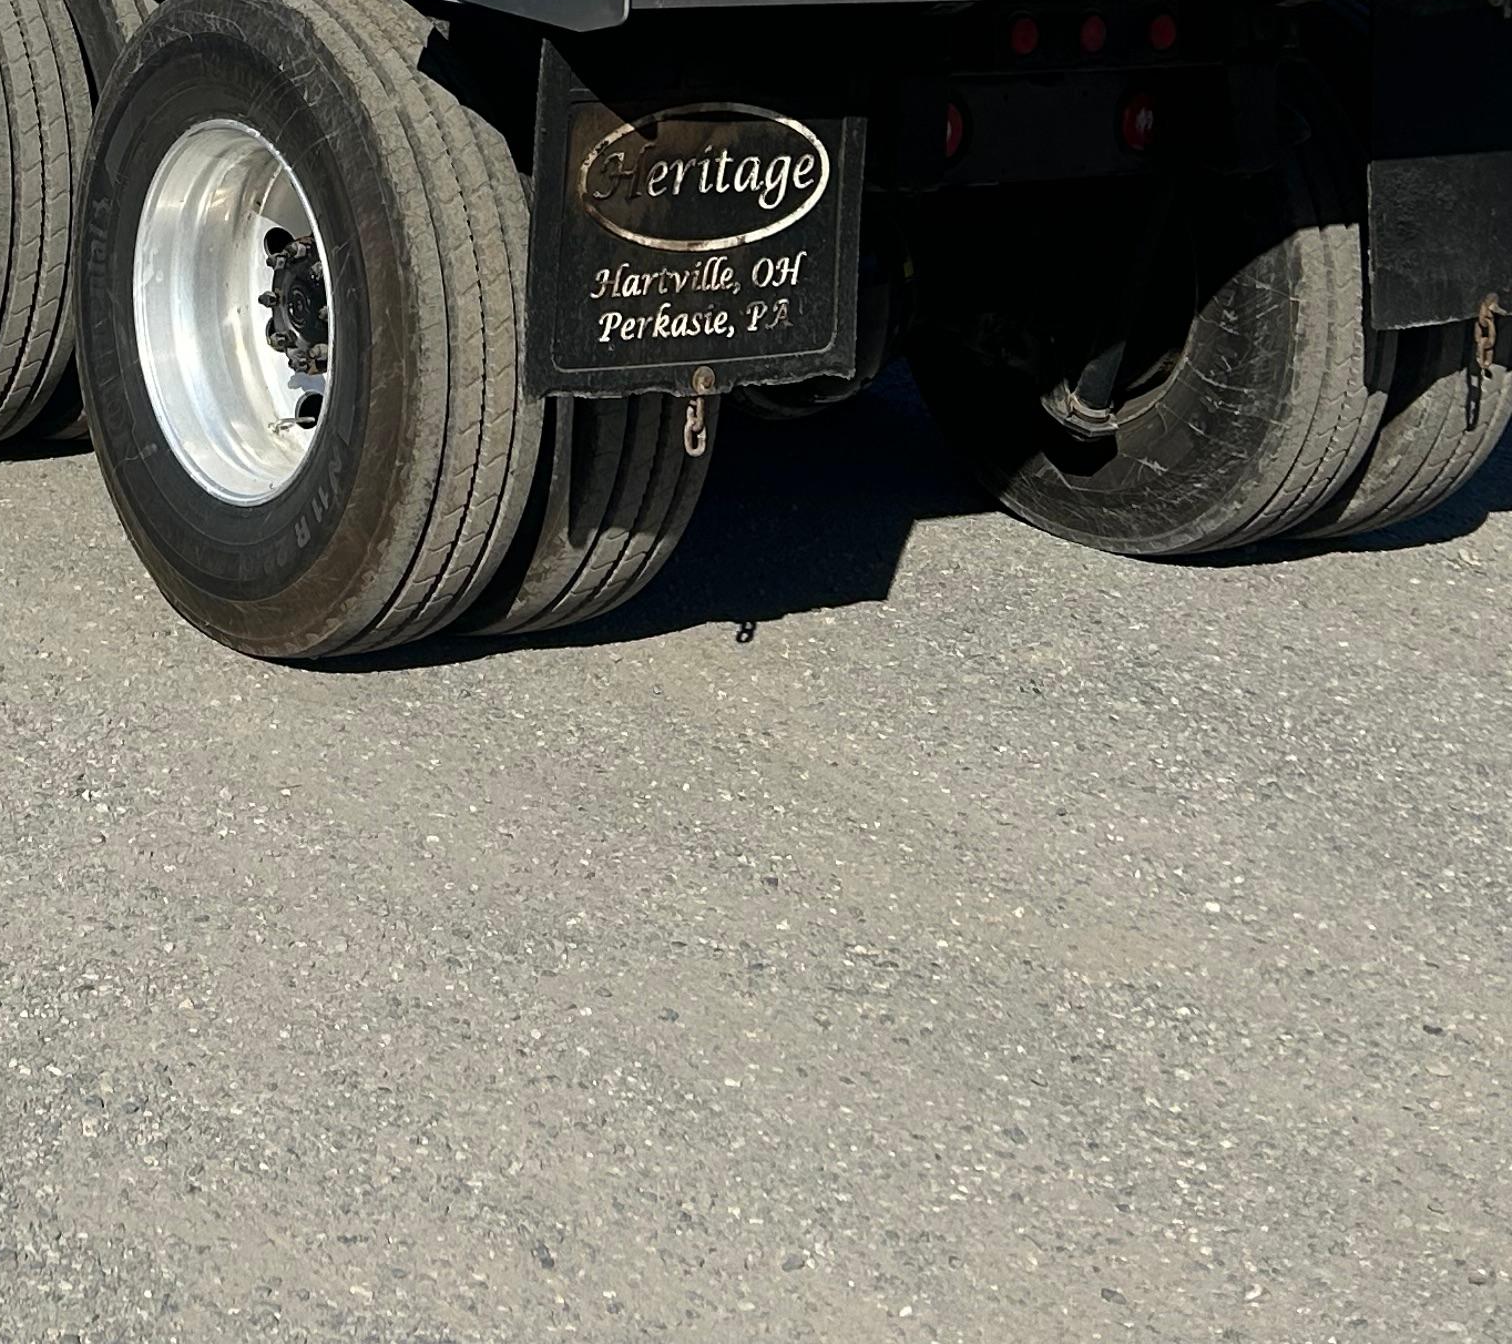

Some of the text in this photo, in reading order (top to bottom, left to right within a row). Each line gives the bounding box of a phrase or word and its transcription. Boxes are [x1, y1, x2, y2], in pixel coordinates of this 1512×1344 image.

[591, 142, 816, 210] Heritage
[590, 251, 808, 299] Hartville, OH
[598, 298, 794, 342] Perkasie, PA
